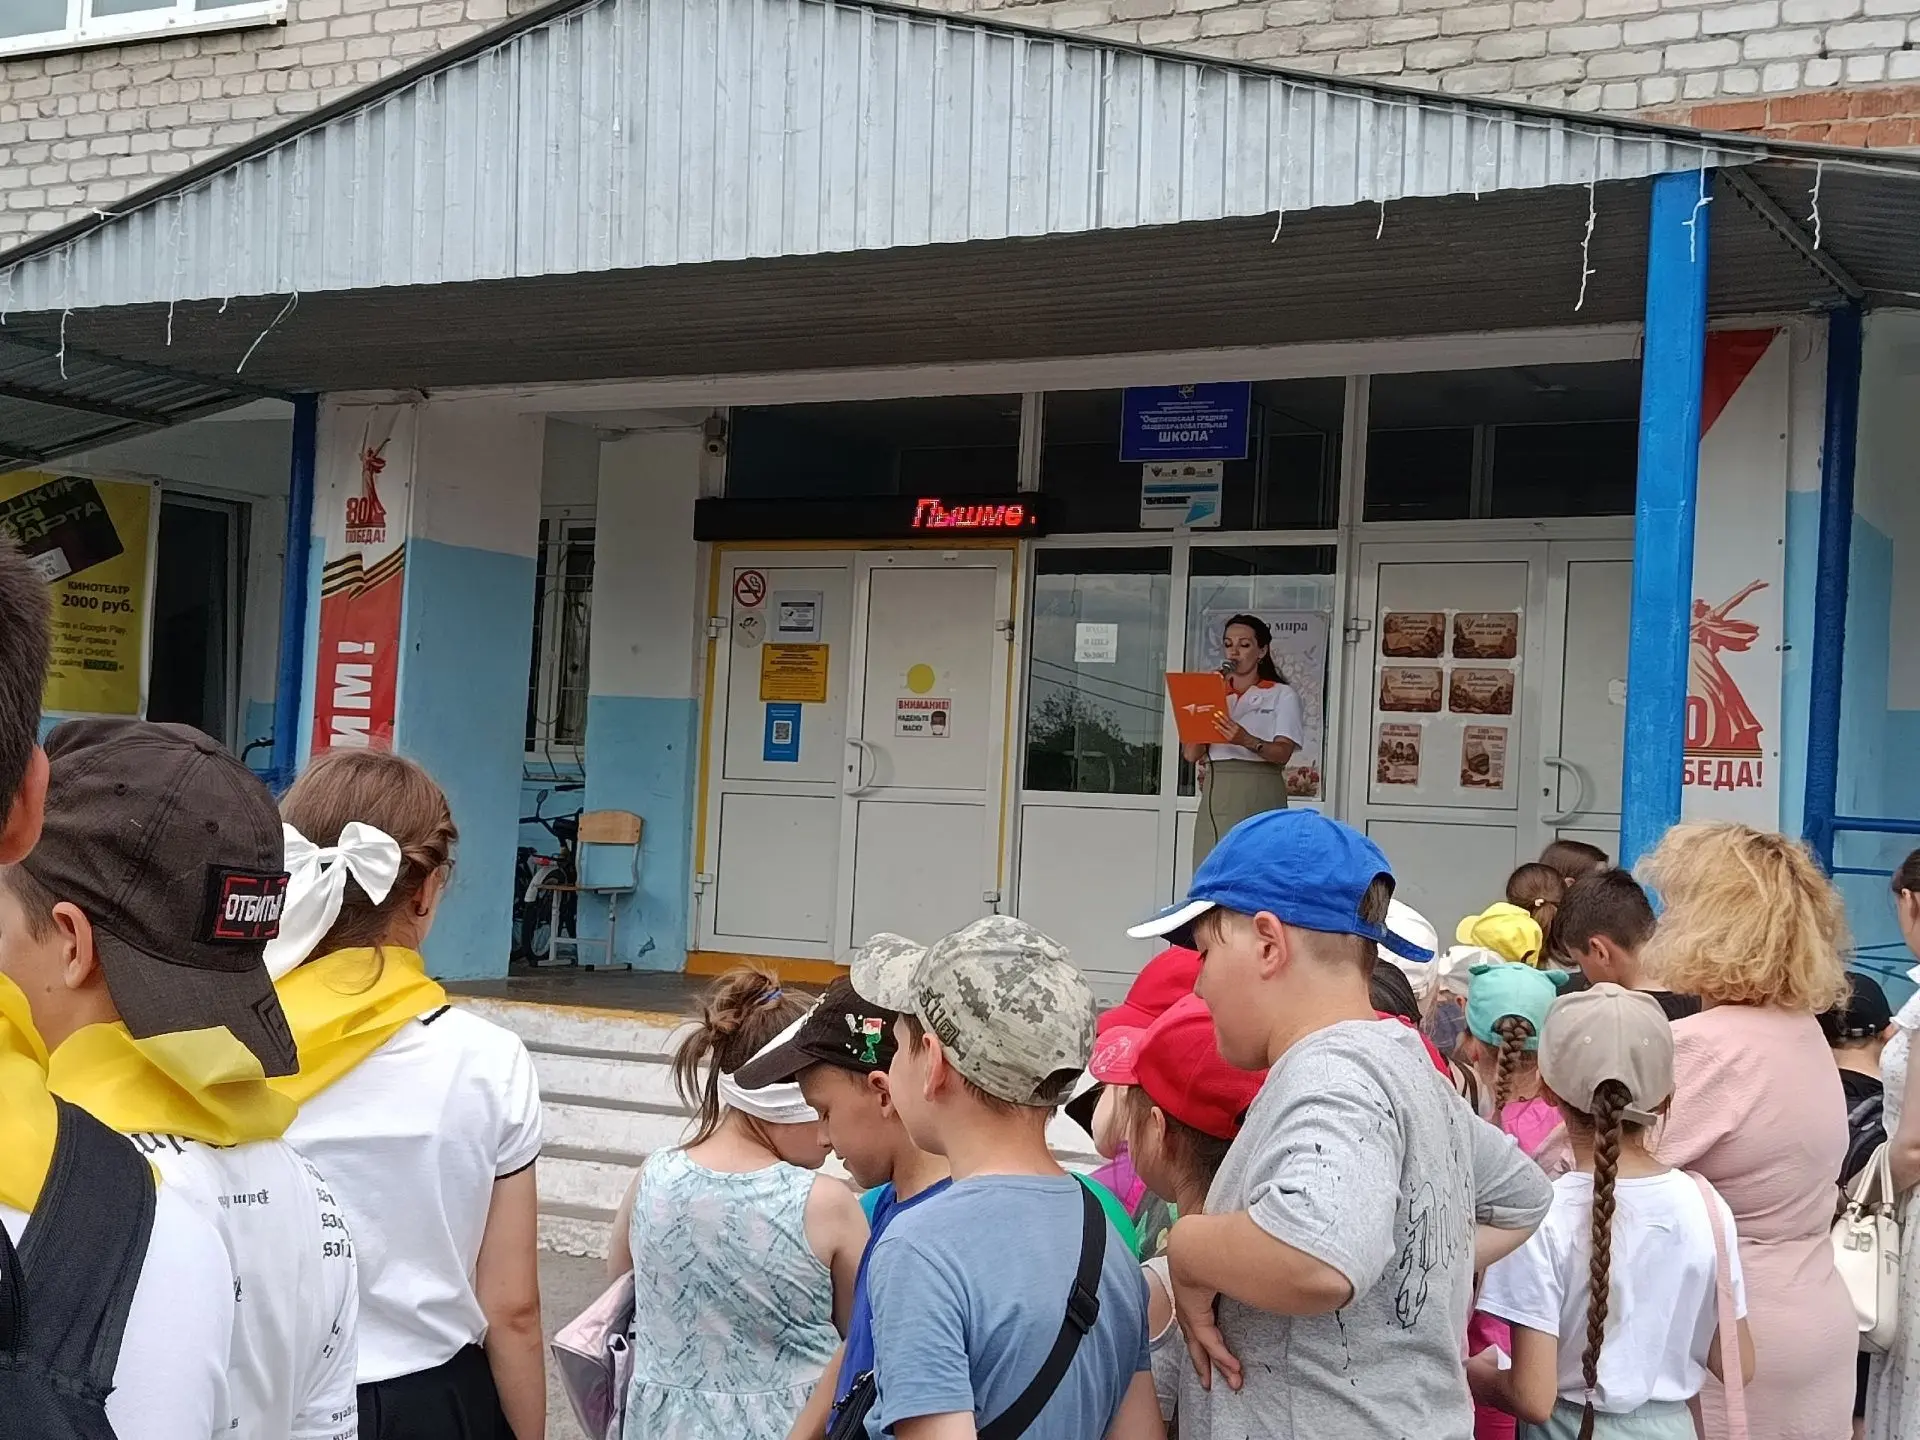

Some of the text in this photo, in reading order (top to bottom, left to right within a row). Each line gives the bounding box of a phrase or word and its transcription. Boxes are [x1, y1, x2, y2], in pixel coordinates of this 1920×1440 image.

[346, 497, 369, 523] 80
[345, 529, 386, 544] ПОБЕДА!
[68, 581, 130, 594] КИНОТЕАТР
[61, 594, 135, 613] 2000 руб.
[1275, 622, 1308, 634] мира
[898, 700, 949, 710] ВНИМАНИЕ!
